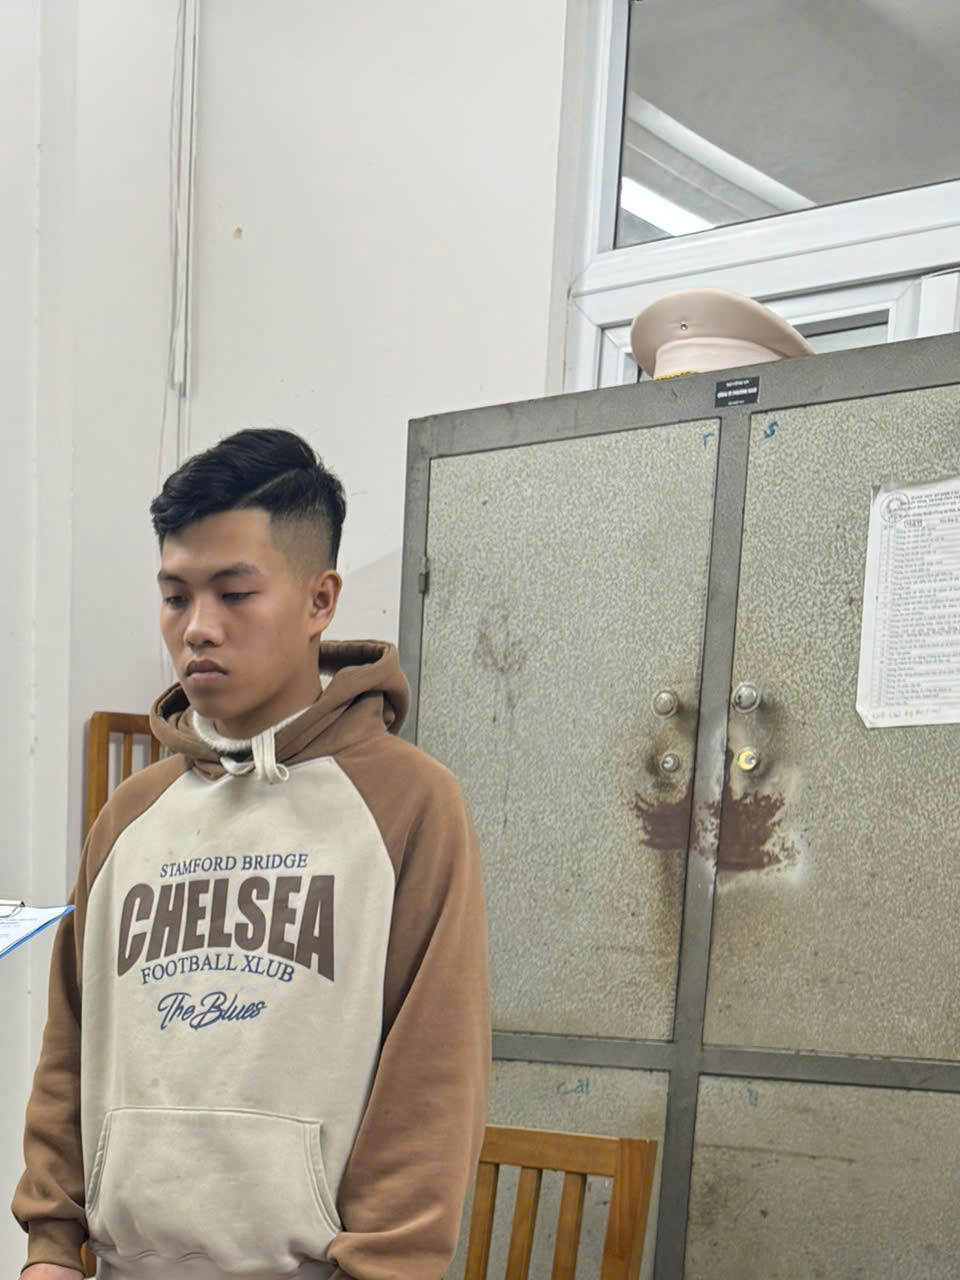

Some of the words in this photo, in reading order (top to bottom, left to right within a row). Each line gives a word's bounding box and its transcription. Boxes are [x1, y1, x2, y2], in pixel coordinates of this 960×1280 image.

[160, 856, 237, 878] STAMFORD
[241, 854, 309, 871] BRIDGE
[117, 874, 335, 982] CHELSEA
[141, 954, 237, 985] FOOTBALL
[240, 955, 296, 983] XLUB
[157, 992, 196, 1030] The
[190, 991, 267, 1030] Blues
